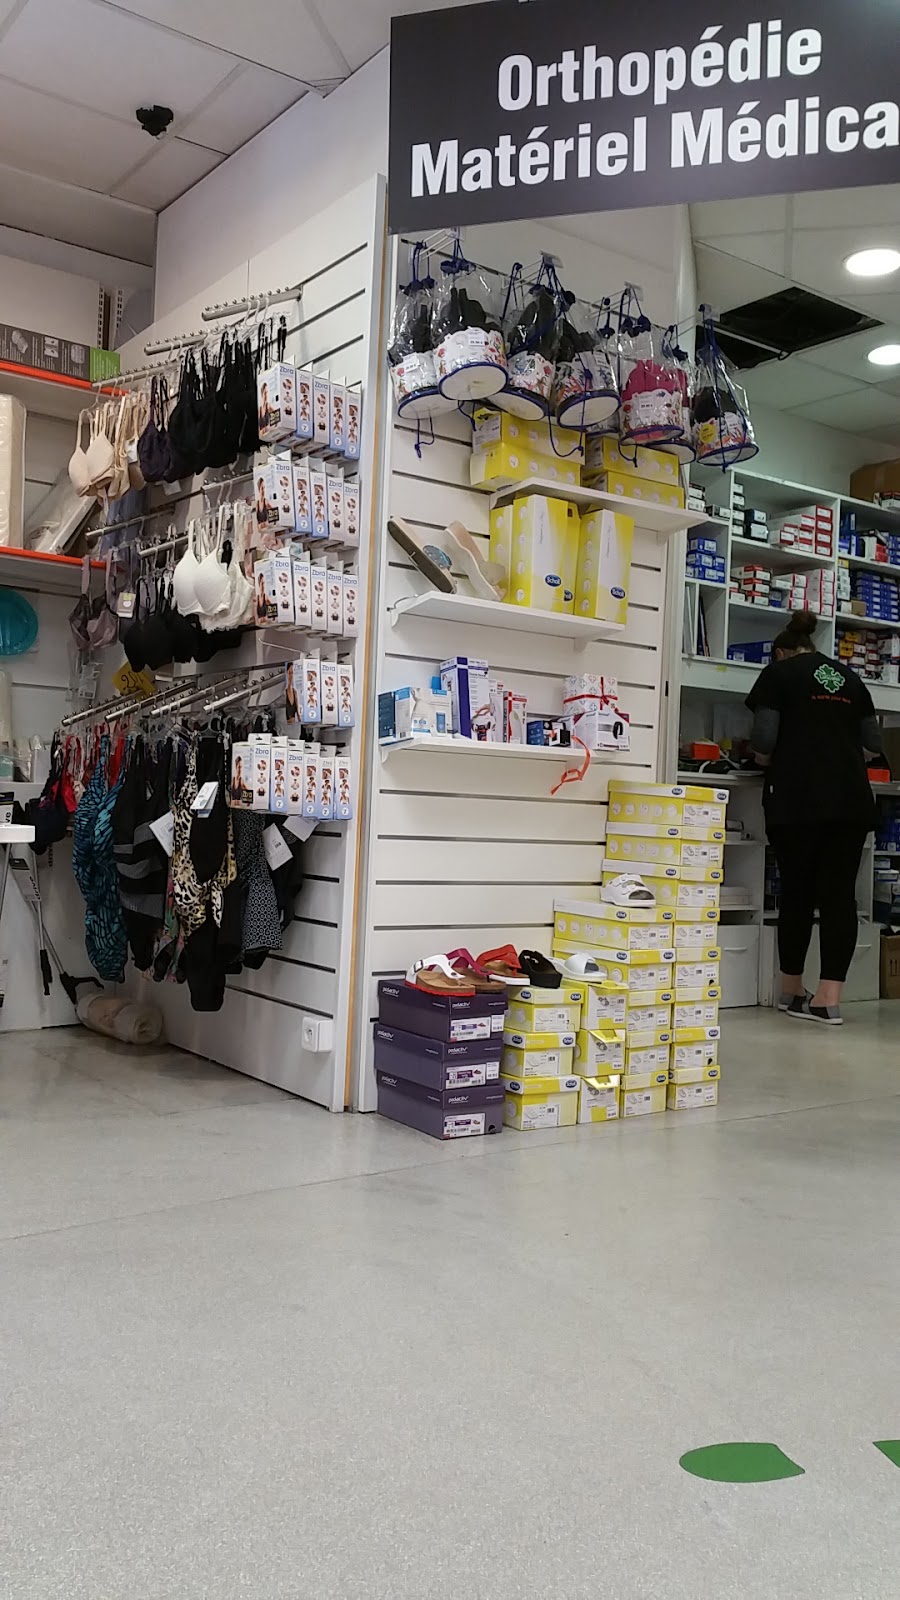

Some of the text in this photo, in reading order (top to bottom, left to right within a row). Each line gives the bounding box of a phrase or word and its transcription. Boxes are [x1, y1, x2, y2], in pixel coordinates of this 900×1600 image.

[498, 19, 822, 111] Orthopédie
[411, 117, 647, 197] Matériel
[280, 365, 294, 374] Zbra
[314, 382, 328, 390] Zbra
[546, 575, 560, 584] Scholl
[612, 588, 625, 598] Scholl
[30, 876, 40, 900] drive
